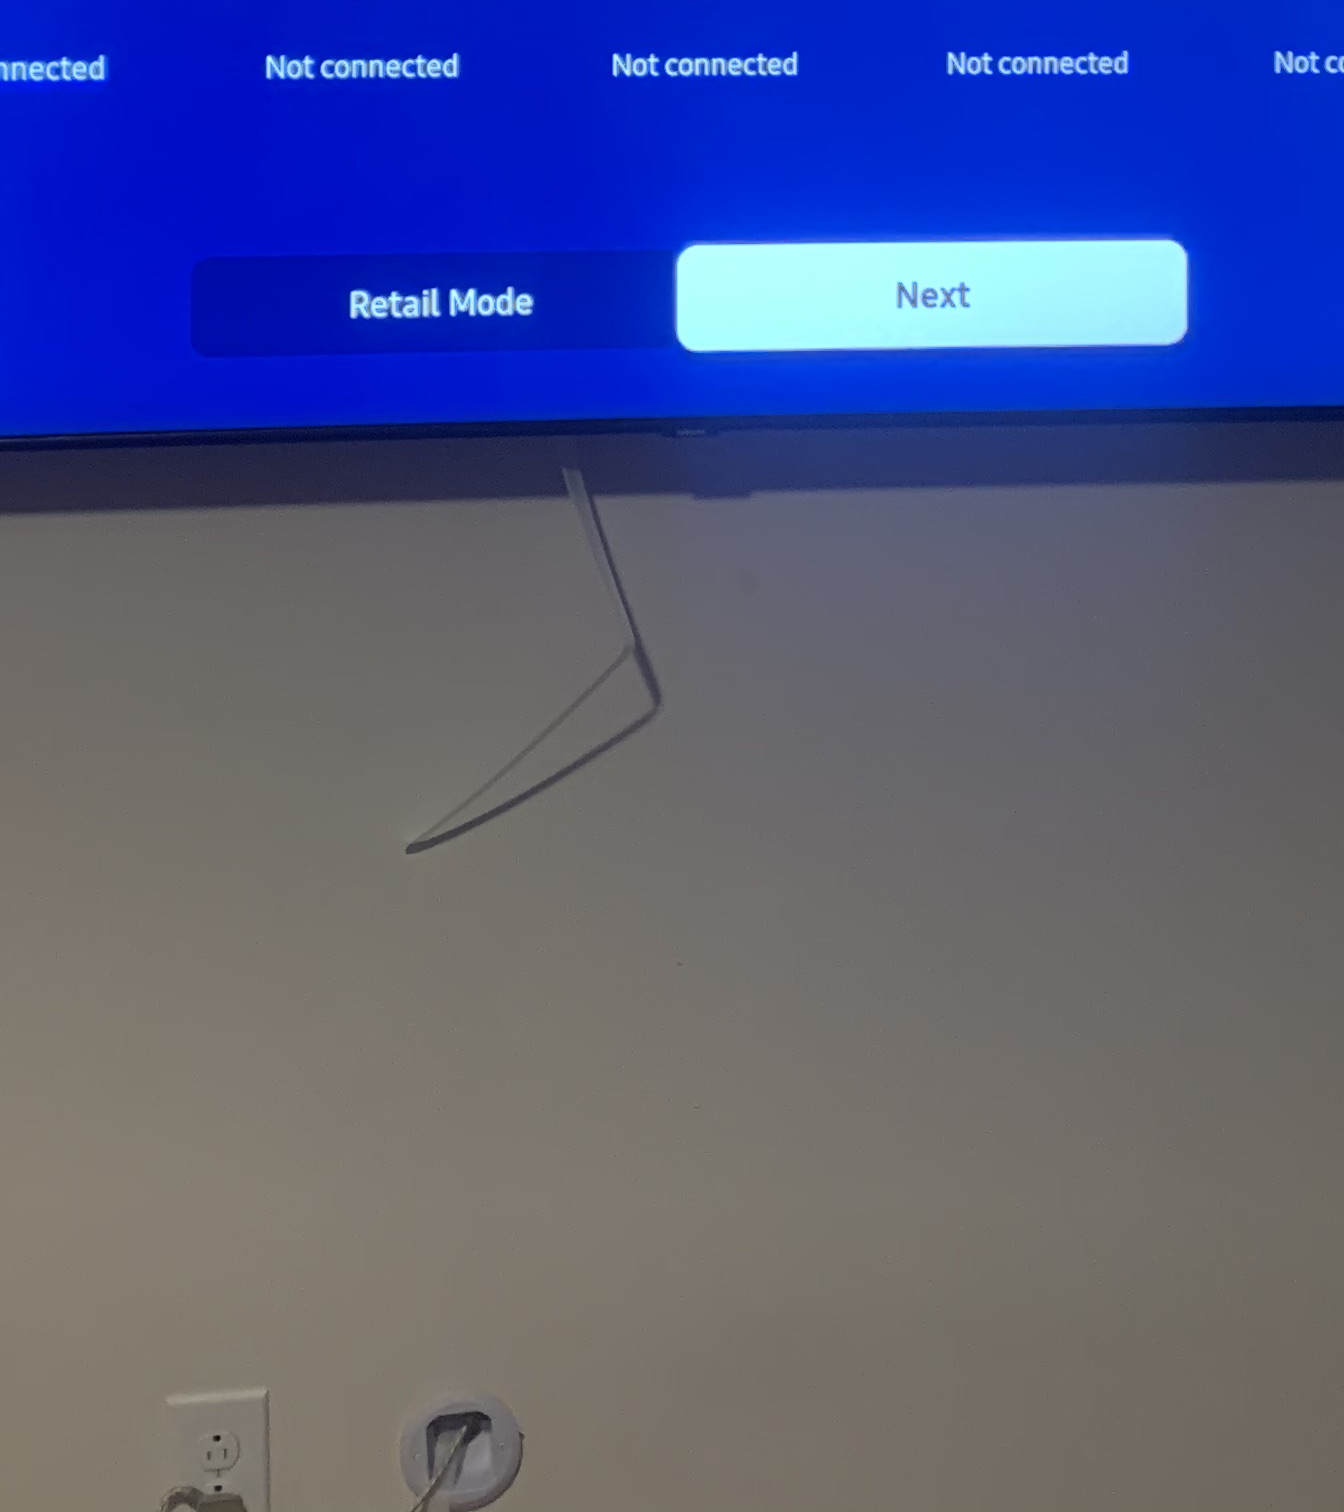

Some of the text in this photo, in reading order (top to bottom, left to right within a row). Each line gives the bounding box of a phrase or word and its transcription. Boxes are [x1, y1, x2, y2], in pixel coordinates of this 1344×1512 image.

[266, 53, 458, 79] Not connected
[613, 52, 797, 76] Not connected
[948, 50, 1128, 75] Not connected
[1275, 51, 1320, 73] Not
[350, 287, 533, 318] Retail Mode
[897, 281, 970, 308] Next
